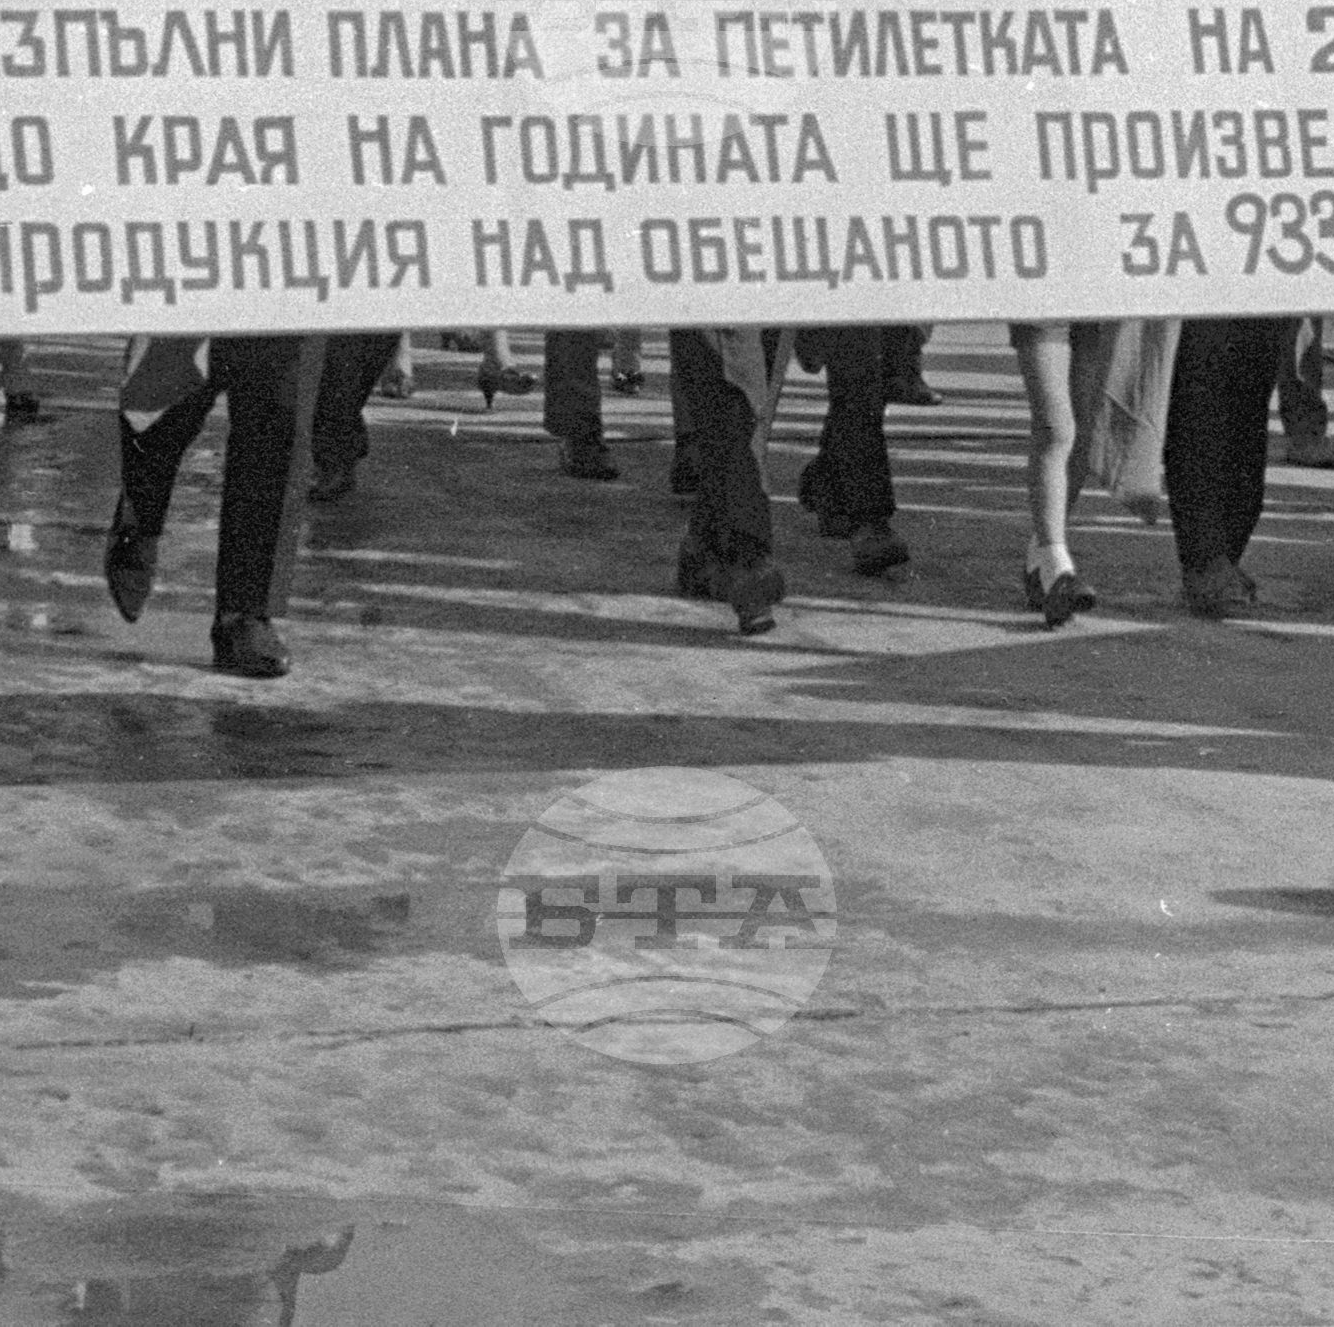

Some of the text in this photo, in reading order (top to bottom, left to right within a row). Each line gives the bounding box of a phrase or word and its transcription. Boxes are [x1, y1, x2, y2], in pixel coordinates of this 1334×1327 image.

[327, 11, 542, 79] ПЛАНА
[596, 11, 680, 77] ЗА
[715, 9, 1128, 77] ПЕТИЛЕТКАТА
[1188, 8, 1275, 74] НА
[113, 115, 299, 186] КРАЯ
[347, 114, 447, 185] НА
[481, 113, 838, 192] ГОДИНАТА
[885, 110, 992, 187] ЩЕ
[472, 218, 614, 294] НАД
[640, 215, 1047, 290] ОБЕЩАНОТО
[1120, 212, 1208, 276] ЗА
